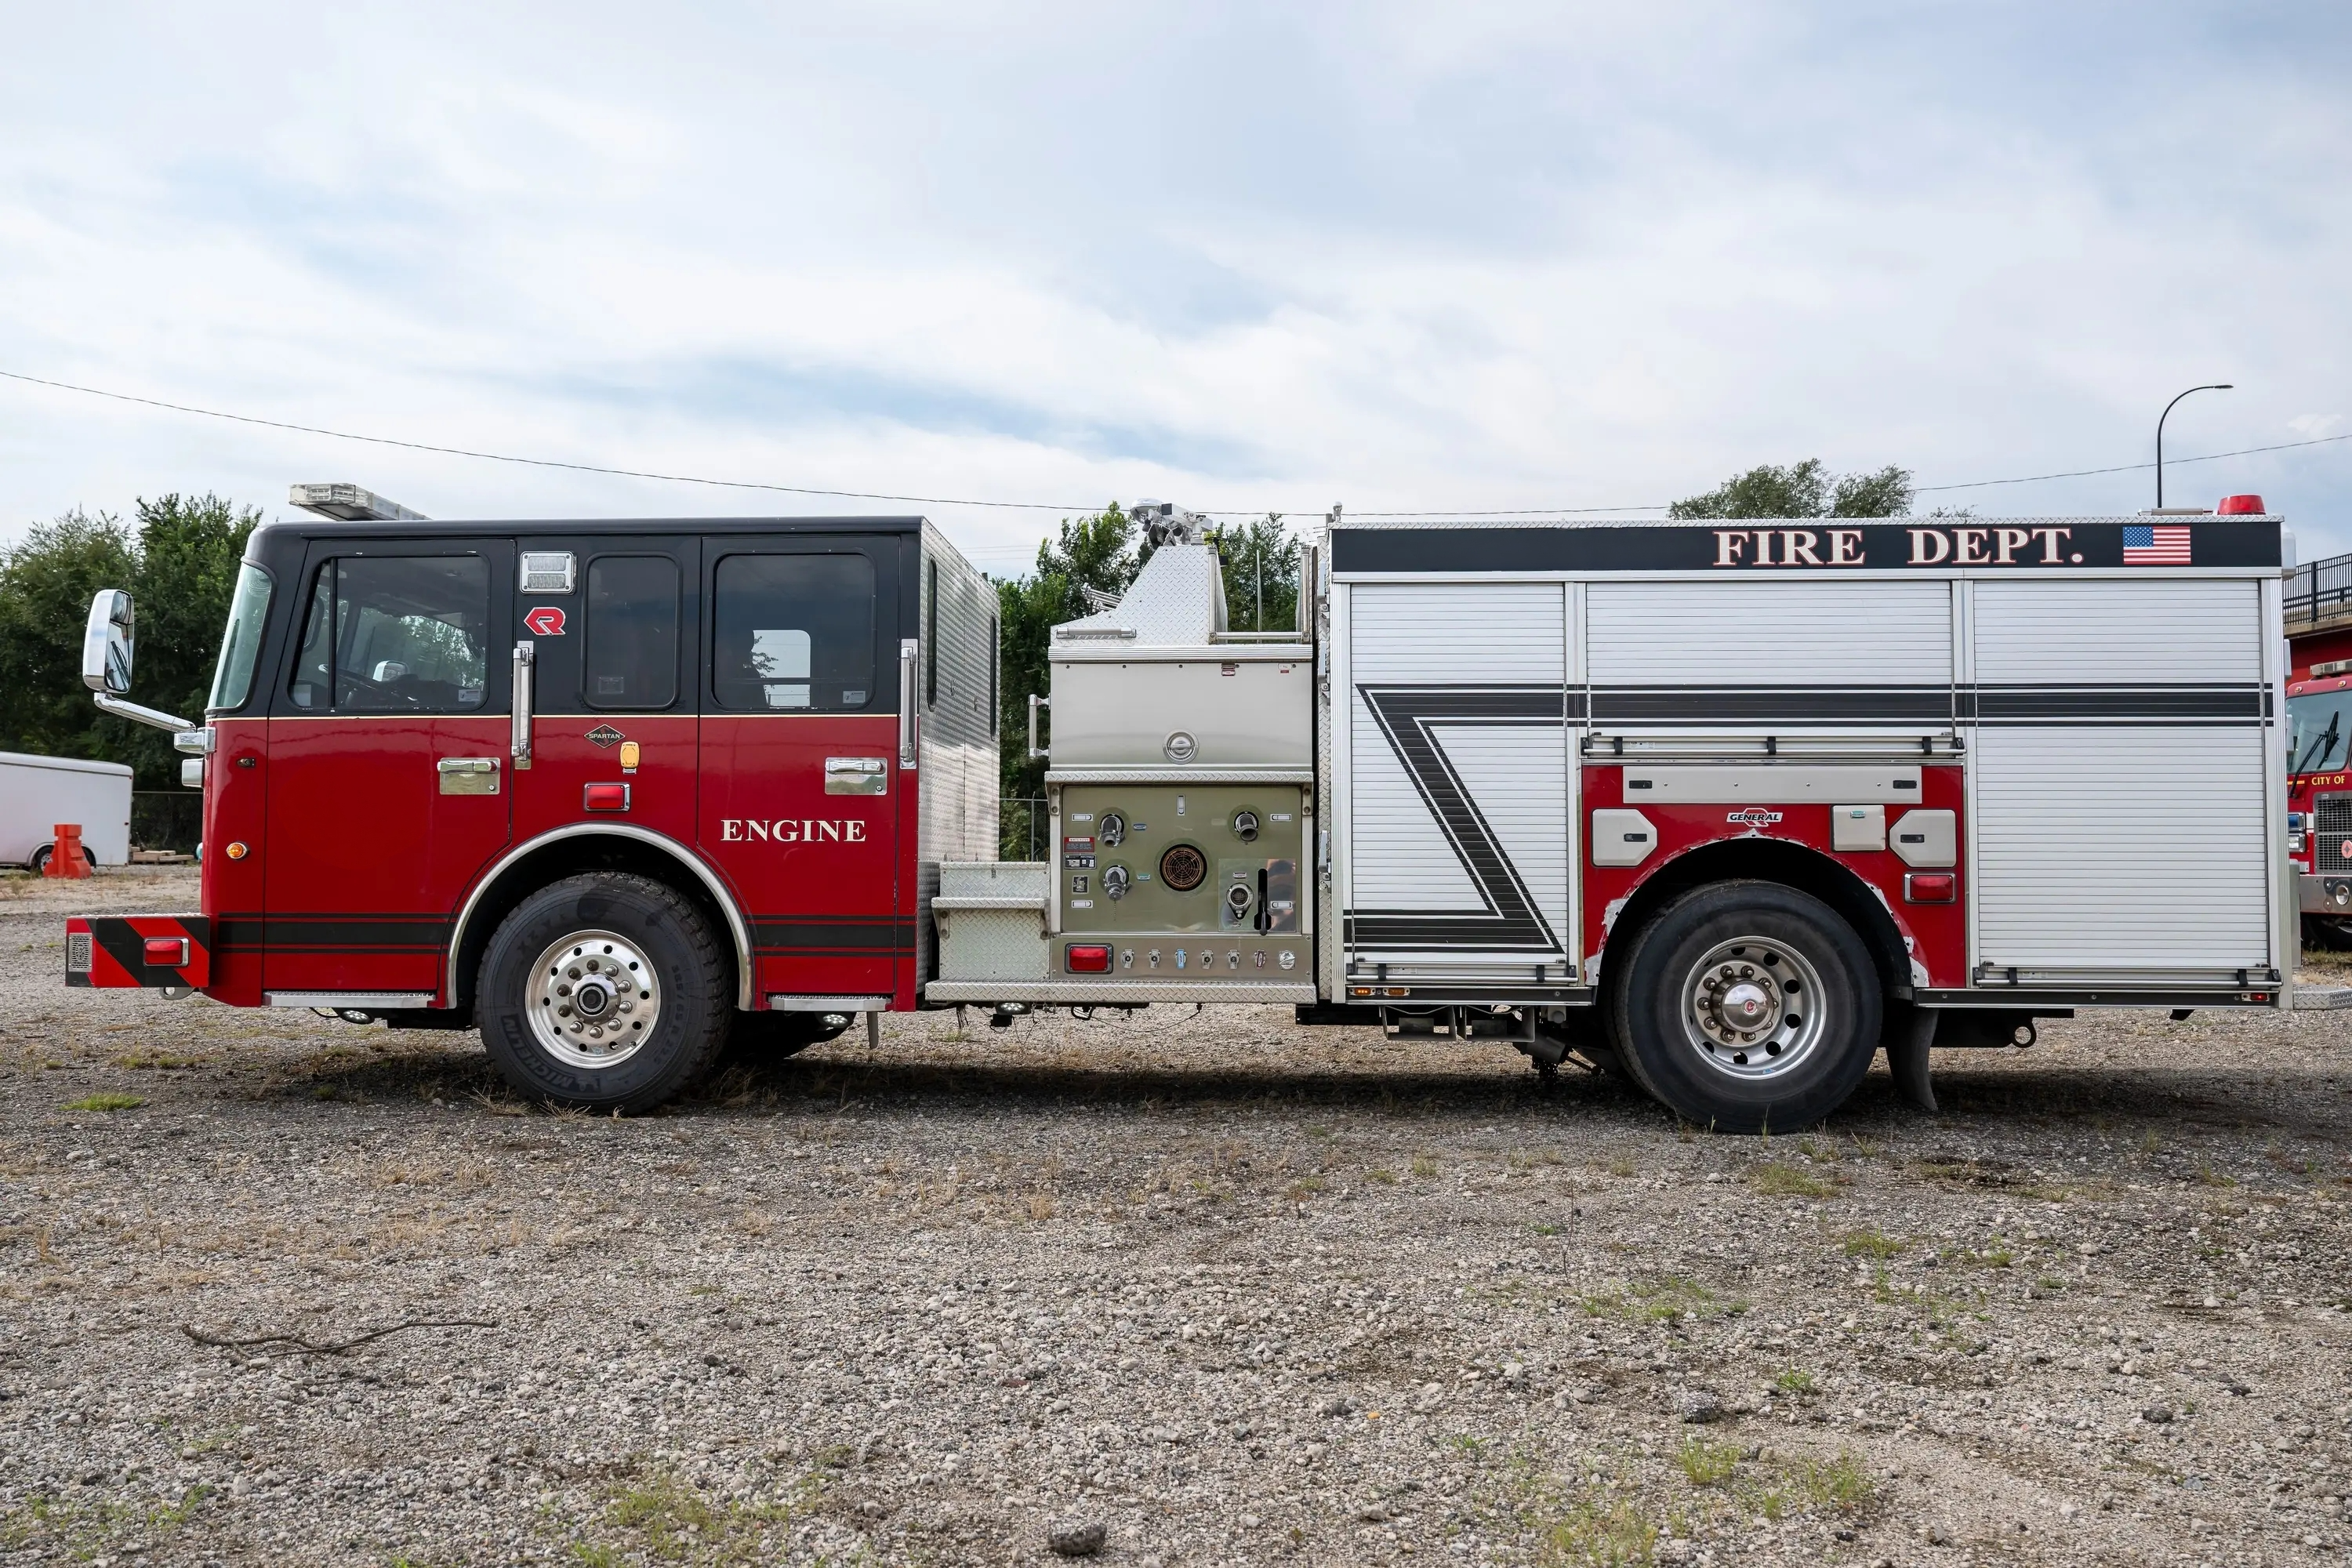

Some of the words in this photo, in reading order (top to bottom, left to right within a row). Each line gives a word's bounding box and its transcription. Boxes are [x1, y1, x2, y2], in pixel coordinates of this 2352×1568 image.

[1712, 530, 1866, 566] FIRE
[1906, 528, 2085, 564] DEPT.
[2311, 776, 2331, 786] CITY
[2333, 775, 2345, 784] OF
[720, 819, 866, 842] ENGINE
[503, 1018, 575, 1088] MICHELIN
